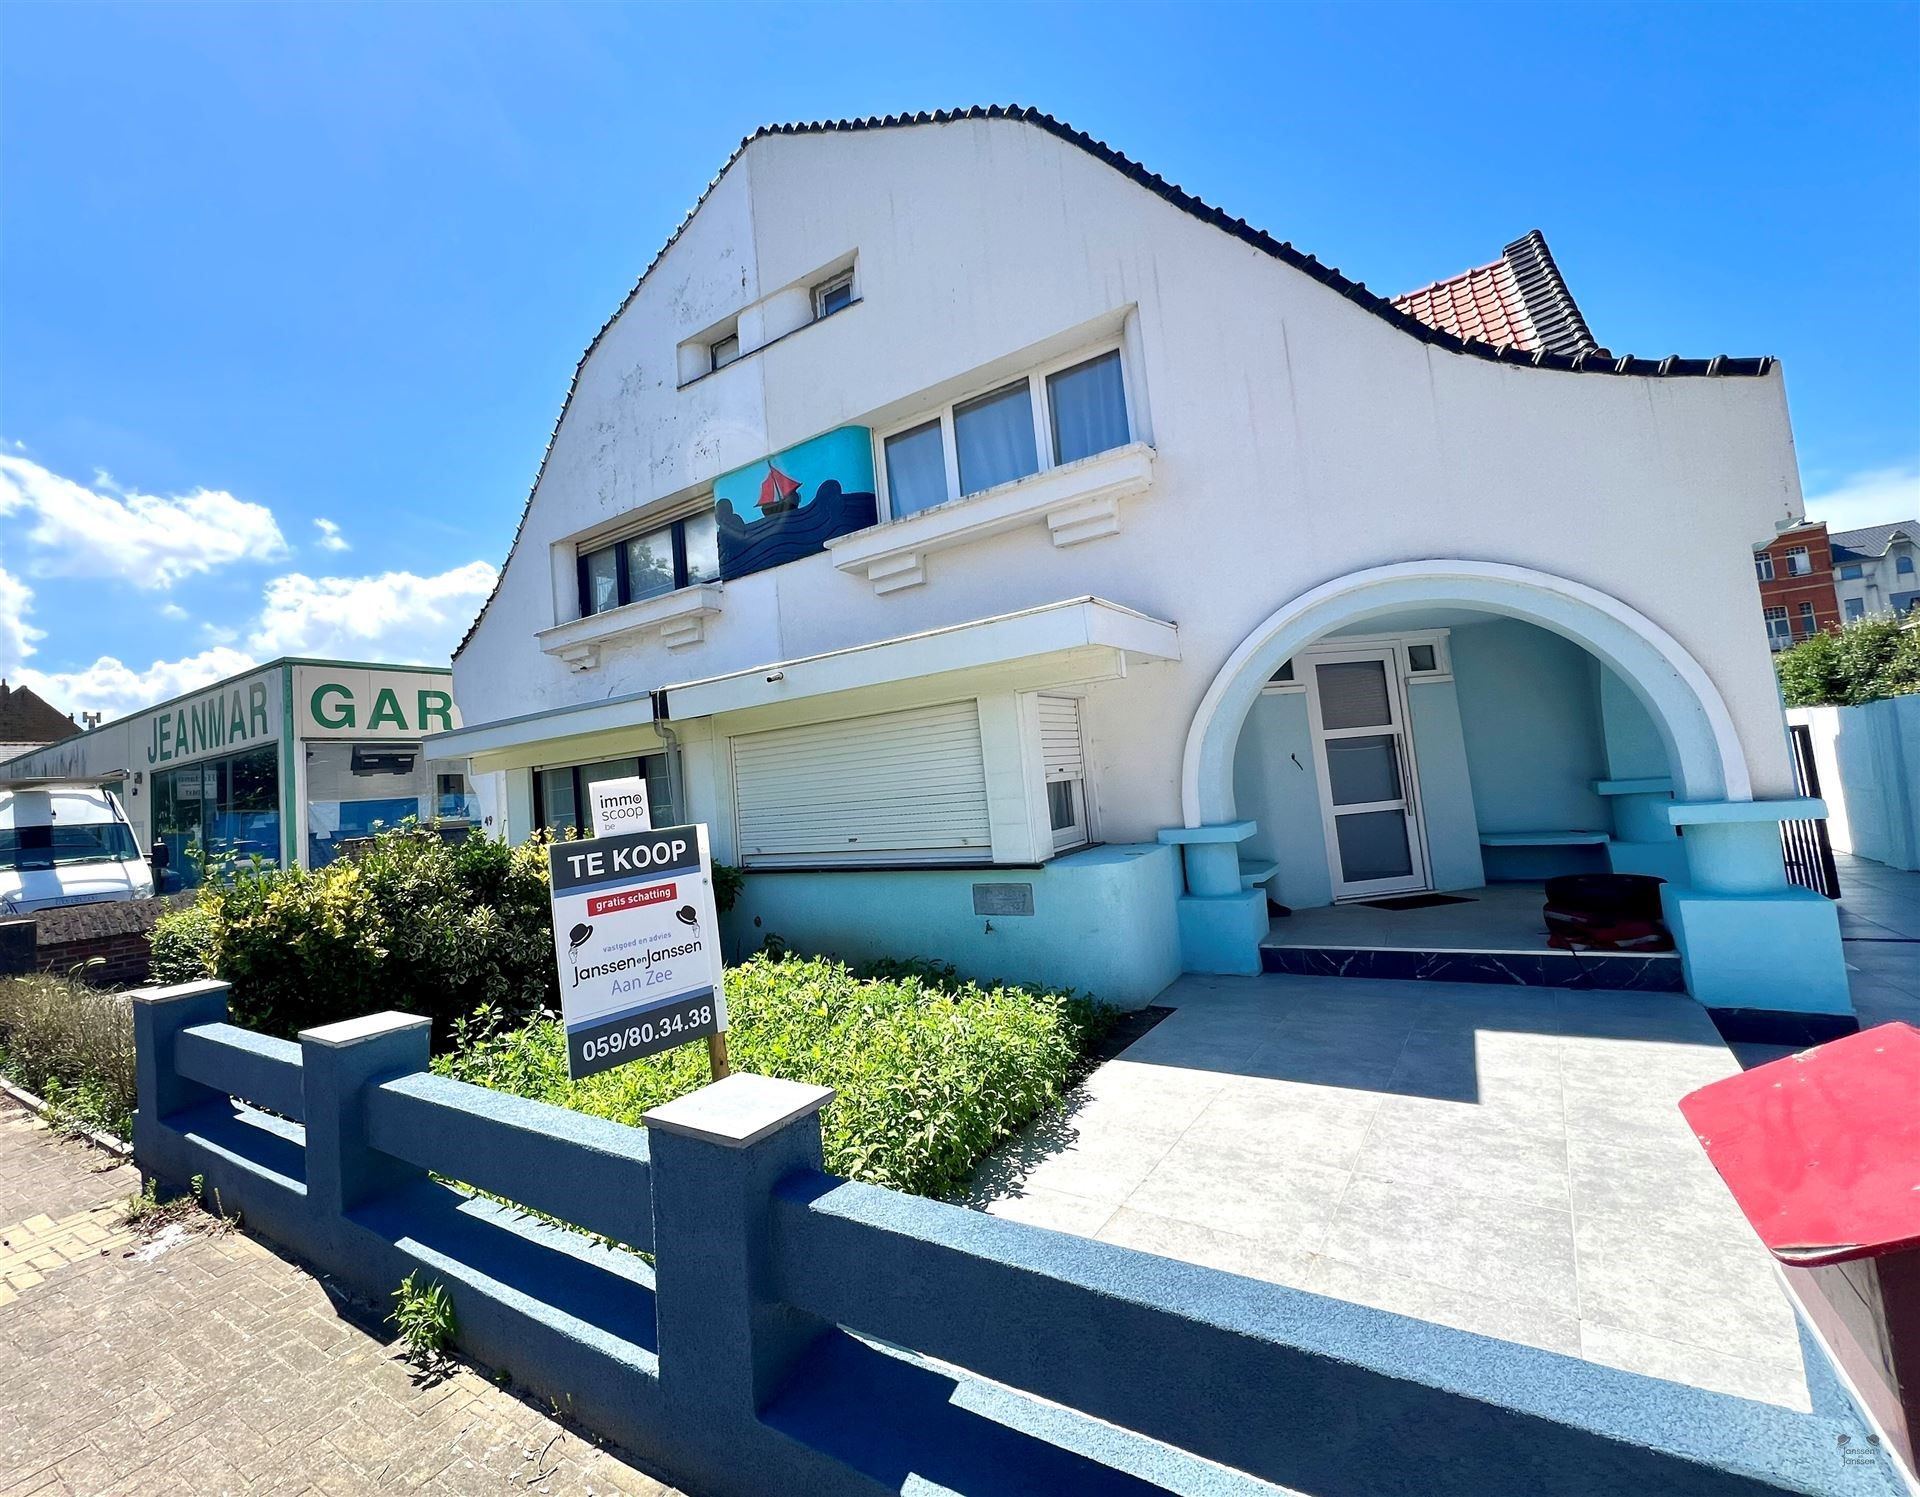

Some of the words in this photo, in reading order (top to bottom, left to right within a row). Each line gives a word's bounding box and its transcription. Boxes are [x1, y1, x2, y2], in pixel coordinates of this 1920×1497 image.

[147, 682, 268, 764] JEANMAR
[600, 794, 642, 808] immo
[601, 806, 643, 821] scoop
[484, 816, 493, 826] 49
[567, 852, 605, 878] TE
[612, 840, 687, 872] KOOP
[596, 896, 626, 912] gratis
[627, 888, 671, 903] schatting
[602, 939, 637, 953] vastgoed
[638, 937, 648, 945] en
[649, 931, 672, 942] advies
[572, 956, 636, 988] Janssen
[645, 940, 702, 969] Janssen
[611, 977, 641, 996] Aan
[645, 969, 673, 986] Zee
[582, 1005, 712, 1062] 059/80.34.38
